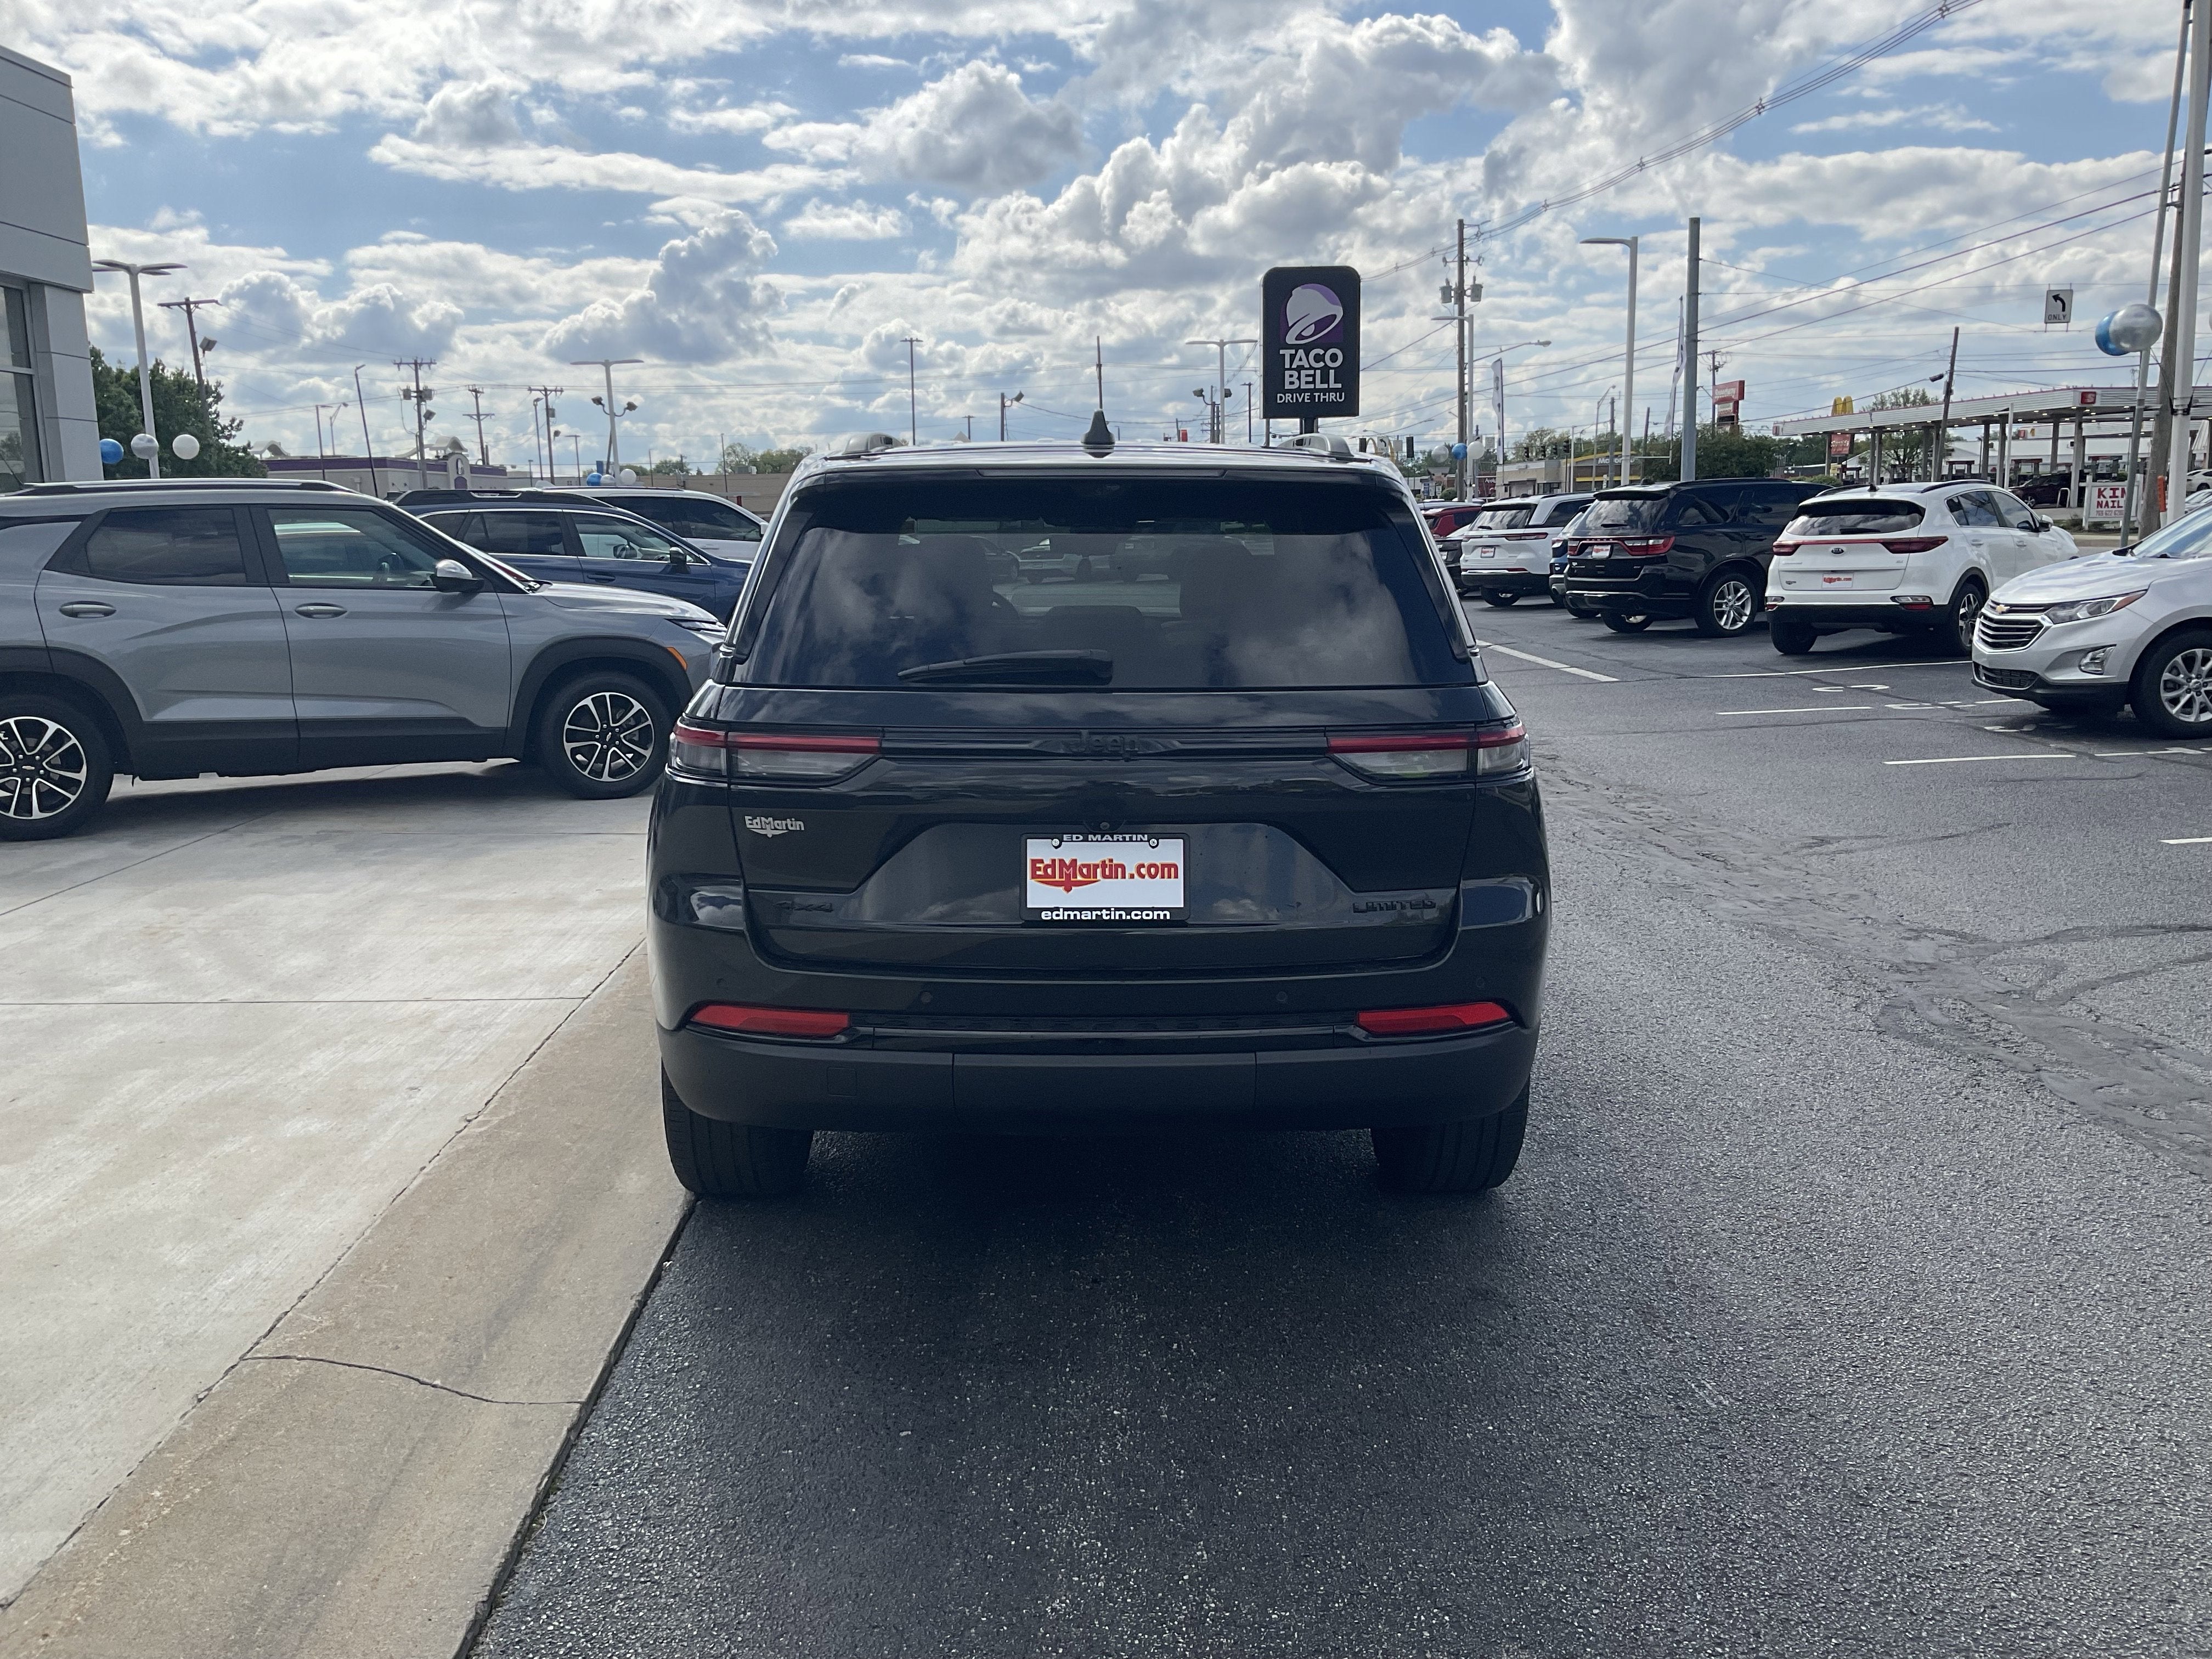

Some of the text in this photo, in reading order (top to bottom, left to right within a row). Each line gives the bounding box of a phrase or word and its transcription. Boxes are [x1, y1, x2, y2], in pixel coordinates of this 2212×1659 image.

[1279, 348, 1344, 368] TACO
[1284, 369, 1342, 390] BELL
[1277, 392, 1345, 403] DRIVE THRU
[2096, 500, 2123, 509] NAIL
[744, 815, 805, 831] EdMartin
[1030, 857, 1179, 880] EdMartin.com
[1041, 907, 1171, 920] edmartin.com
